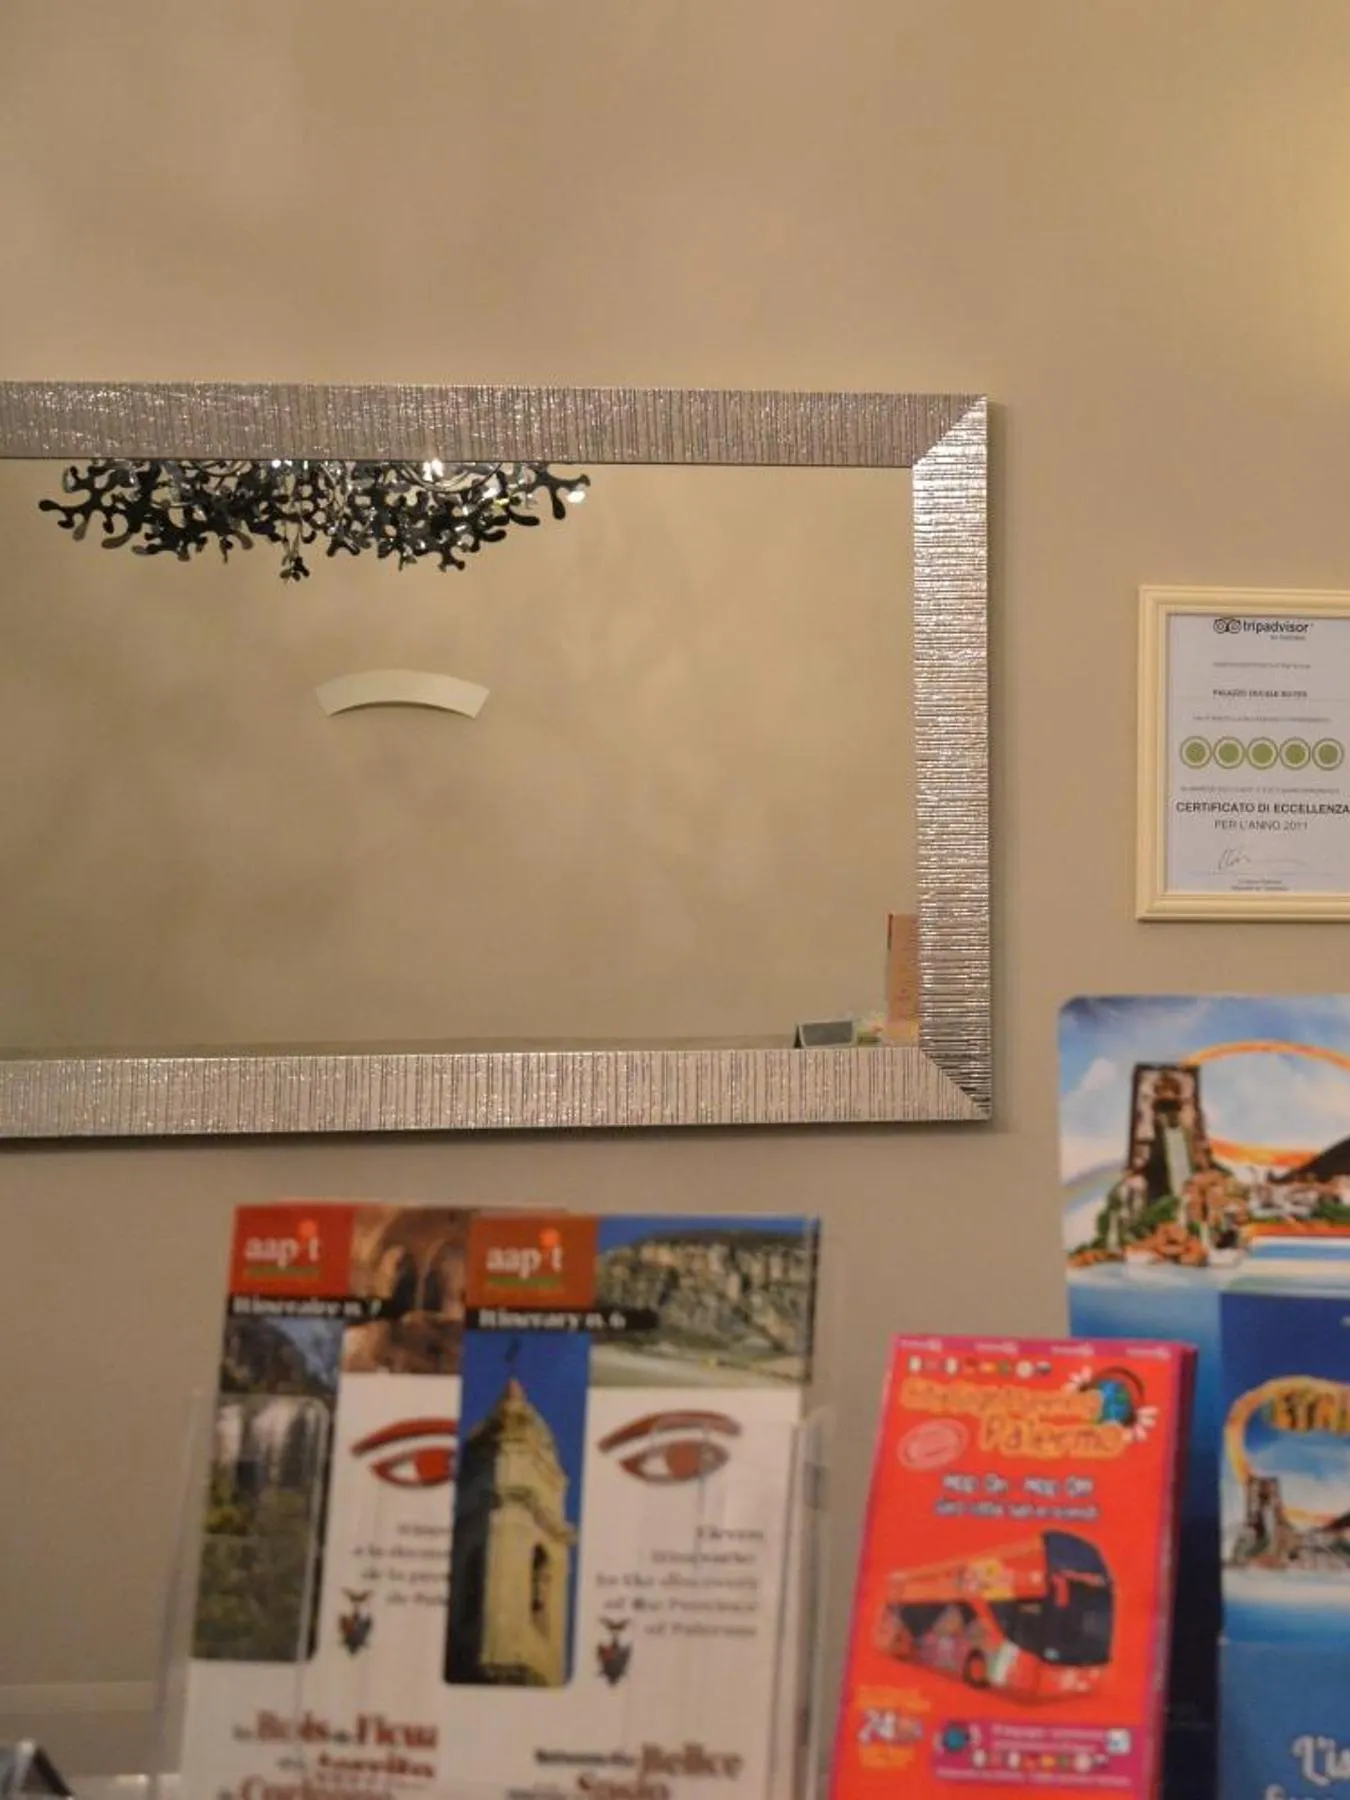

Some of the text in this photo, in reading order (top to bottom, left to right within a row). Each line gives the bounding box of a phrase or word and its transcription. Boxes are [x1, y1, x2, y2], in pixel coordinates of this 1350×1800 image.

[1242, 620, 1310, 635] tripadvisor
[1176, 801, 1350, 815] CERTIFICATO DI ECCELLENZA
[1214, 820, 1309, 830] PER L'ANNO 2011
[477, 1307, 580, 1331] Itinerary
[608, 1310, 627, 1329] 6
[984, 1412, 1124, 1454] Palermo
